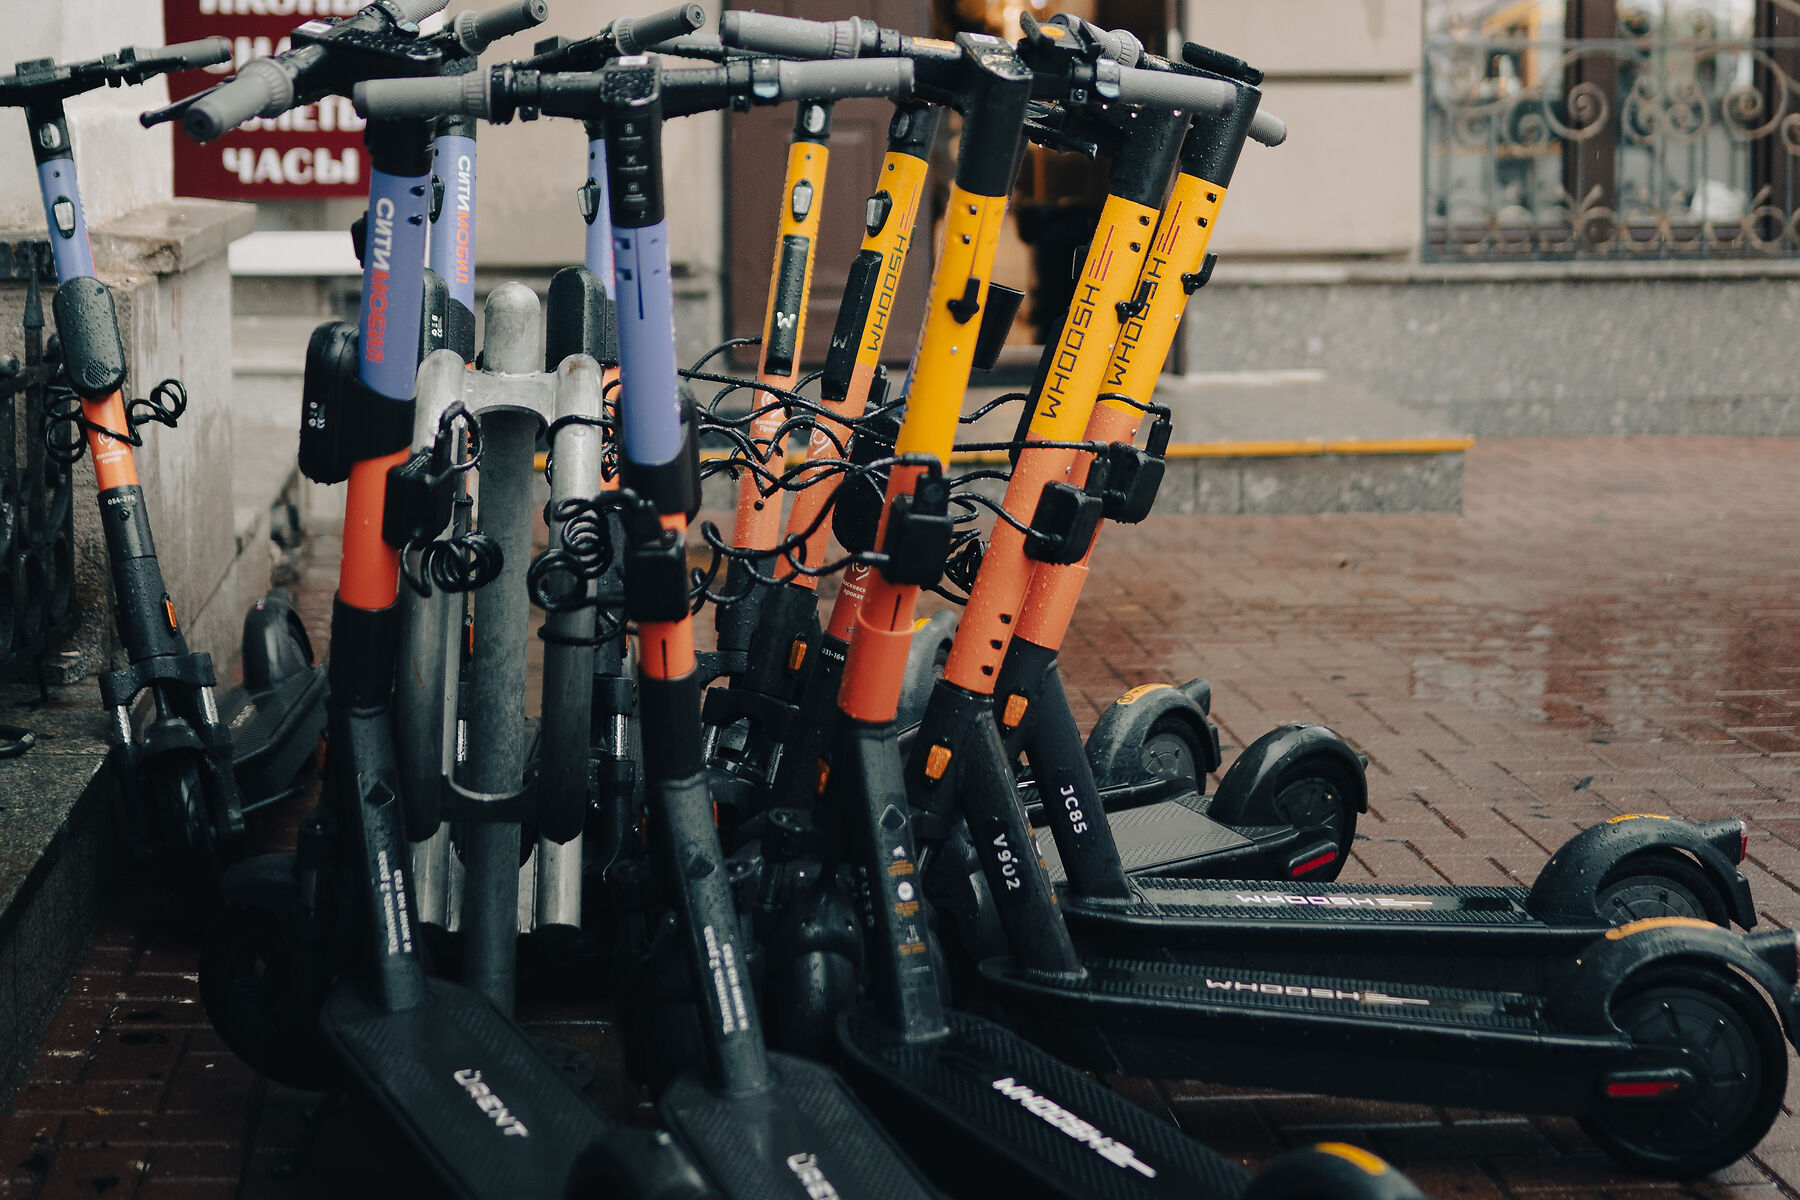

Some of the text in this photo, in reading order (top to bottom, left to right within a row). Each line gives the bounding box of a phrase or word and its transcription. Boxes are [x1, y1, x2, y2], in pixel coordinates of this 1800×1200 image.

[222, 147, 360, 185] ЧАСЫ
[365, 197, 395, 364] СИТИМОБИЛ
[866, 233, 908, 352] WHOOSH
[1040, 284, 1101, 419] WHOOSH
[1060, 784, 1088, 834] JC85
[1205, 977, 1360, 1001] WHOOSH
